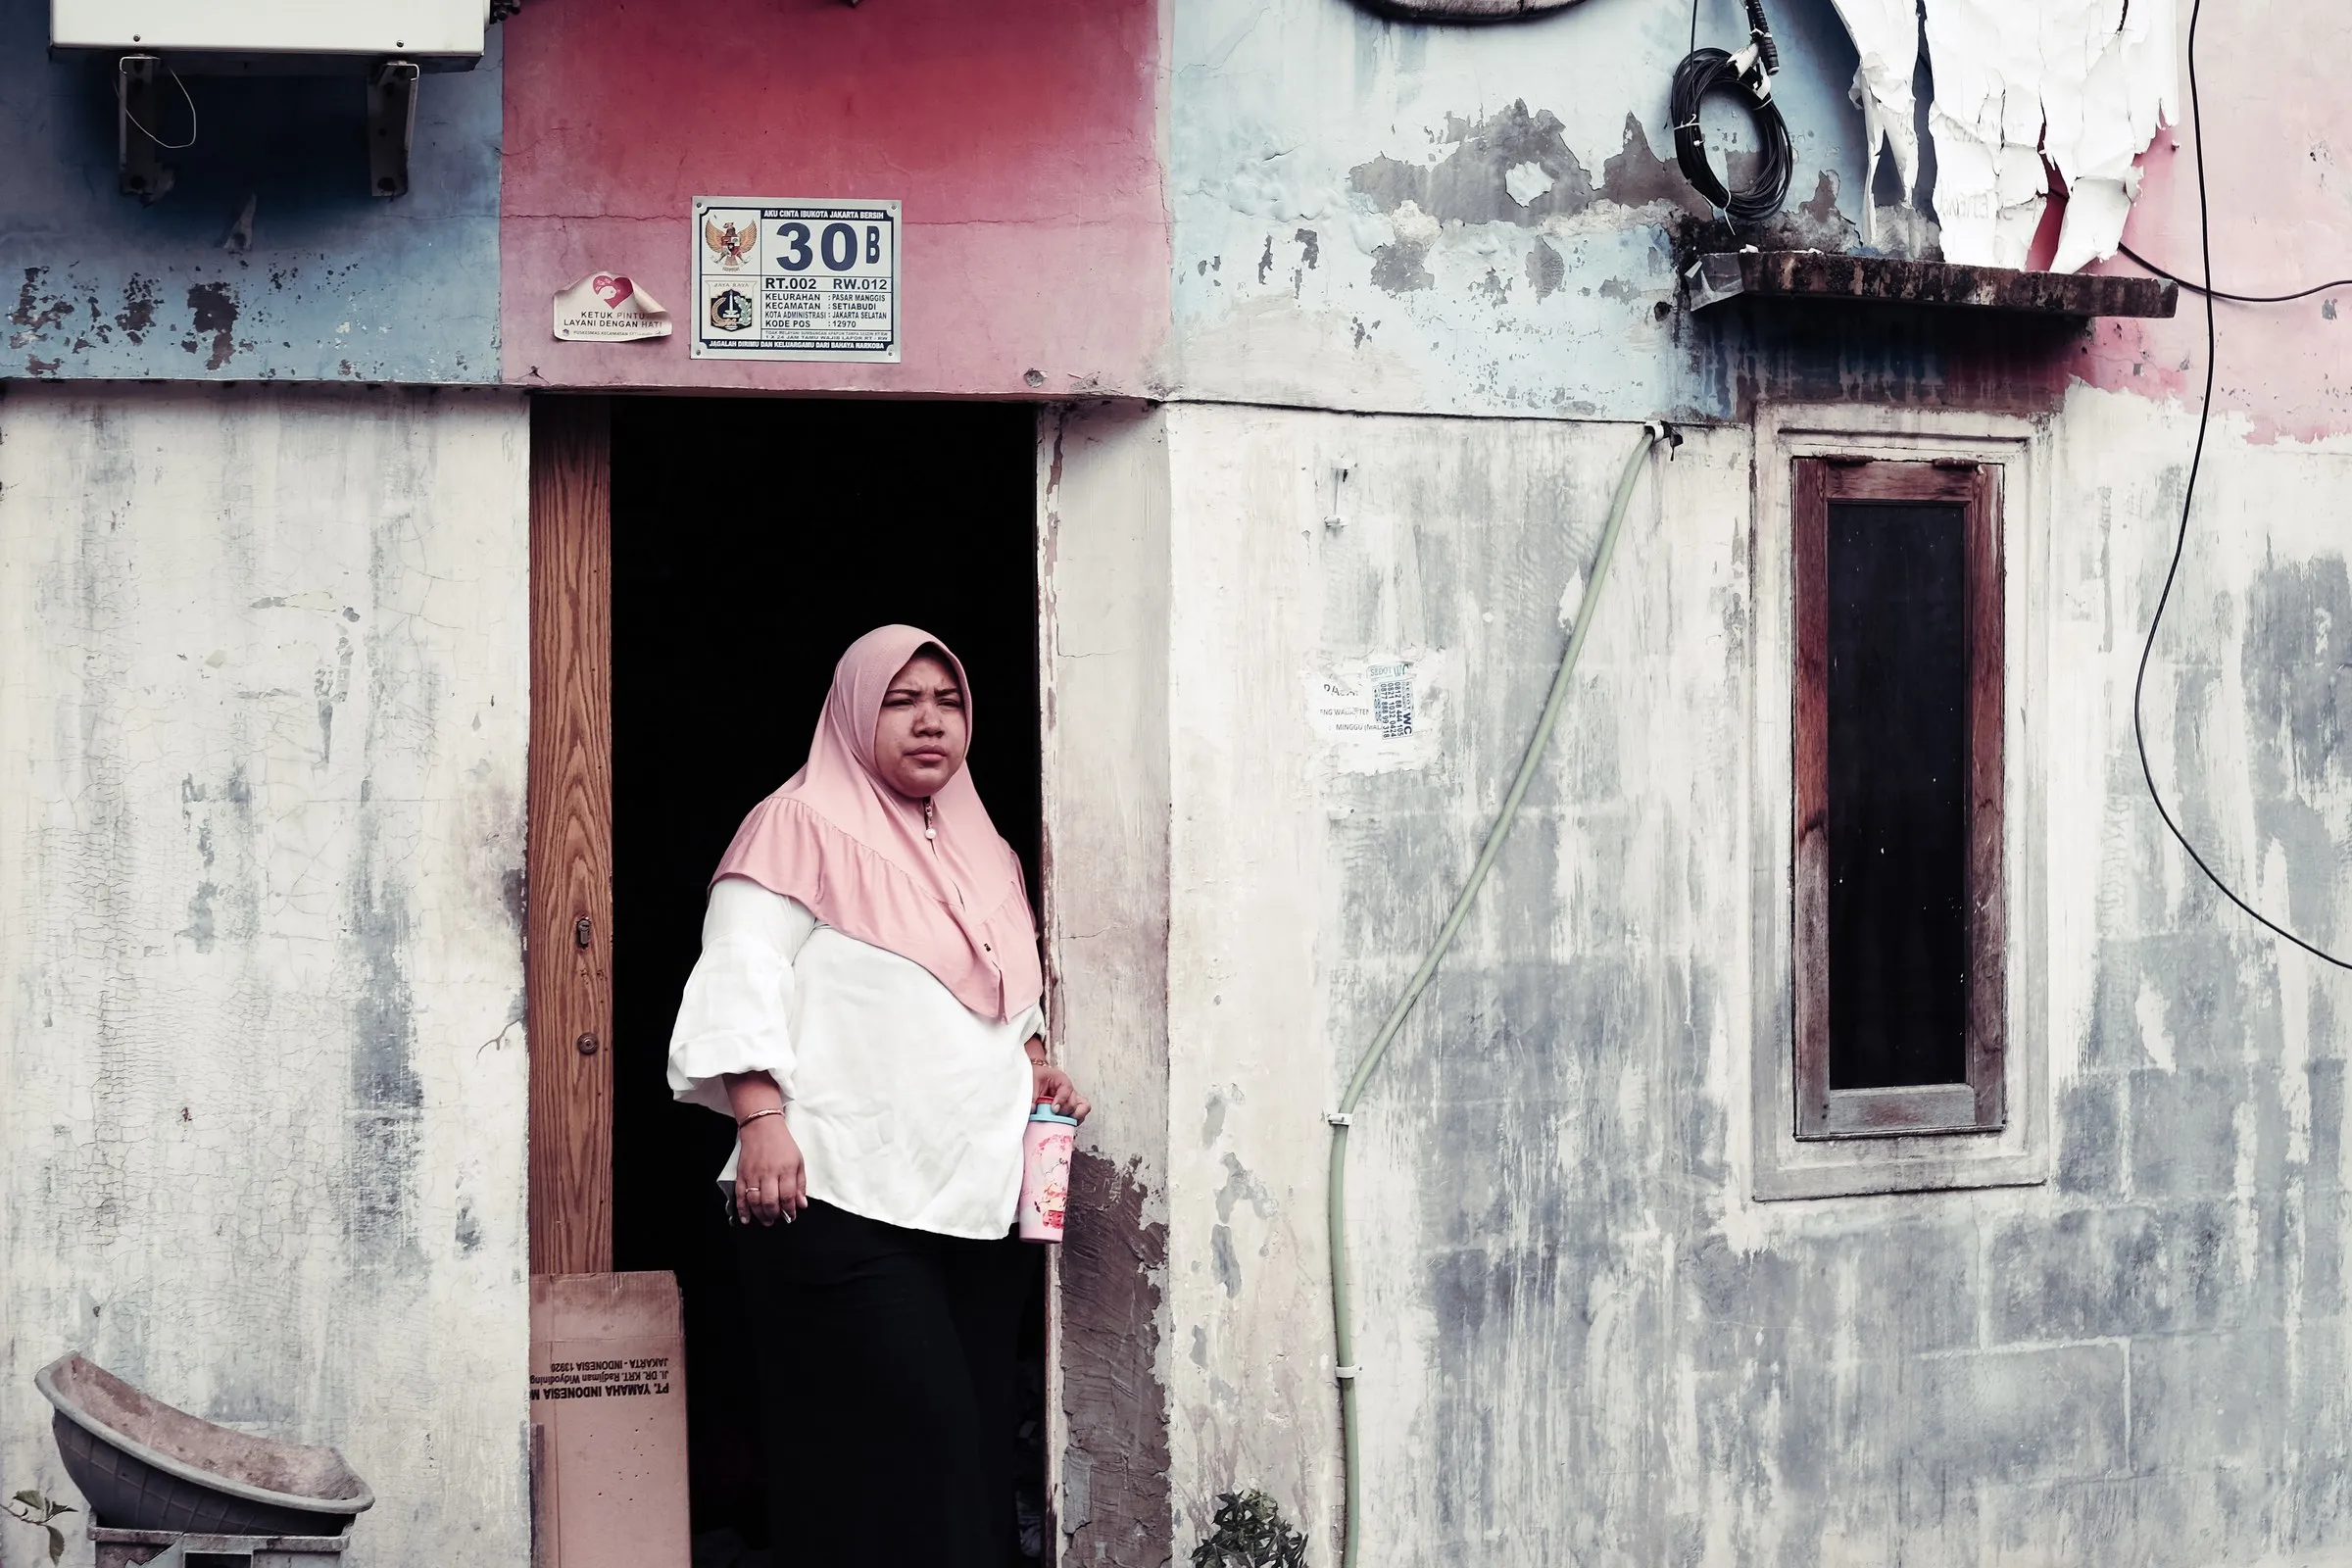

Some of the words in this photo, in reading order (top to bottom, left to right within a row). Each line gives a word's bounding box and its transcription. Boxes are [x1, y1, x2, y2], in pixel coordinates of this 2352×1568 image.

[776, 222, 858, 271] 30
[866, 226, 881, 264] B
[765, 278, 817, 290] RT.002
[833, 279, 887, 290] RW.012
[1371, 667, 1392, 676] SEDOT
[1382, 715, 1389, 724] 99
[1403, 712, 1412, 735] WC
[550, 1362, 574, 1372] 13920
[576, 1360, 623, 1372] INDONESIA
[629, 1358, 669, 1369] JAKARTA
[582, 1372, 620, 1382] Radjiman
[621, 1372, 641, 1381] KRT.
[645, 1372, 657, 1380] DR.
[543, 1386, 602, 1400] INDONESIA
[605, 1383, 651, 1396] YAMAHA
[654, 1383, 669, 1394] PT.
